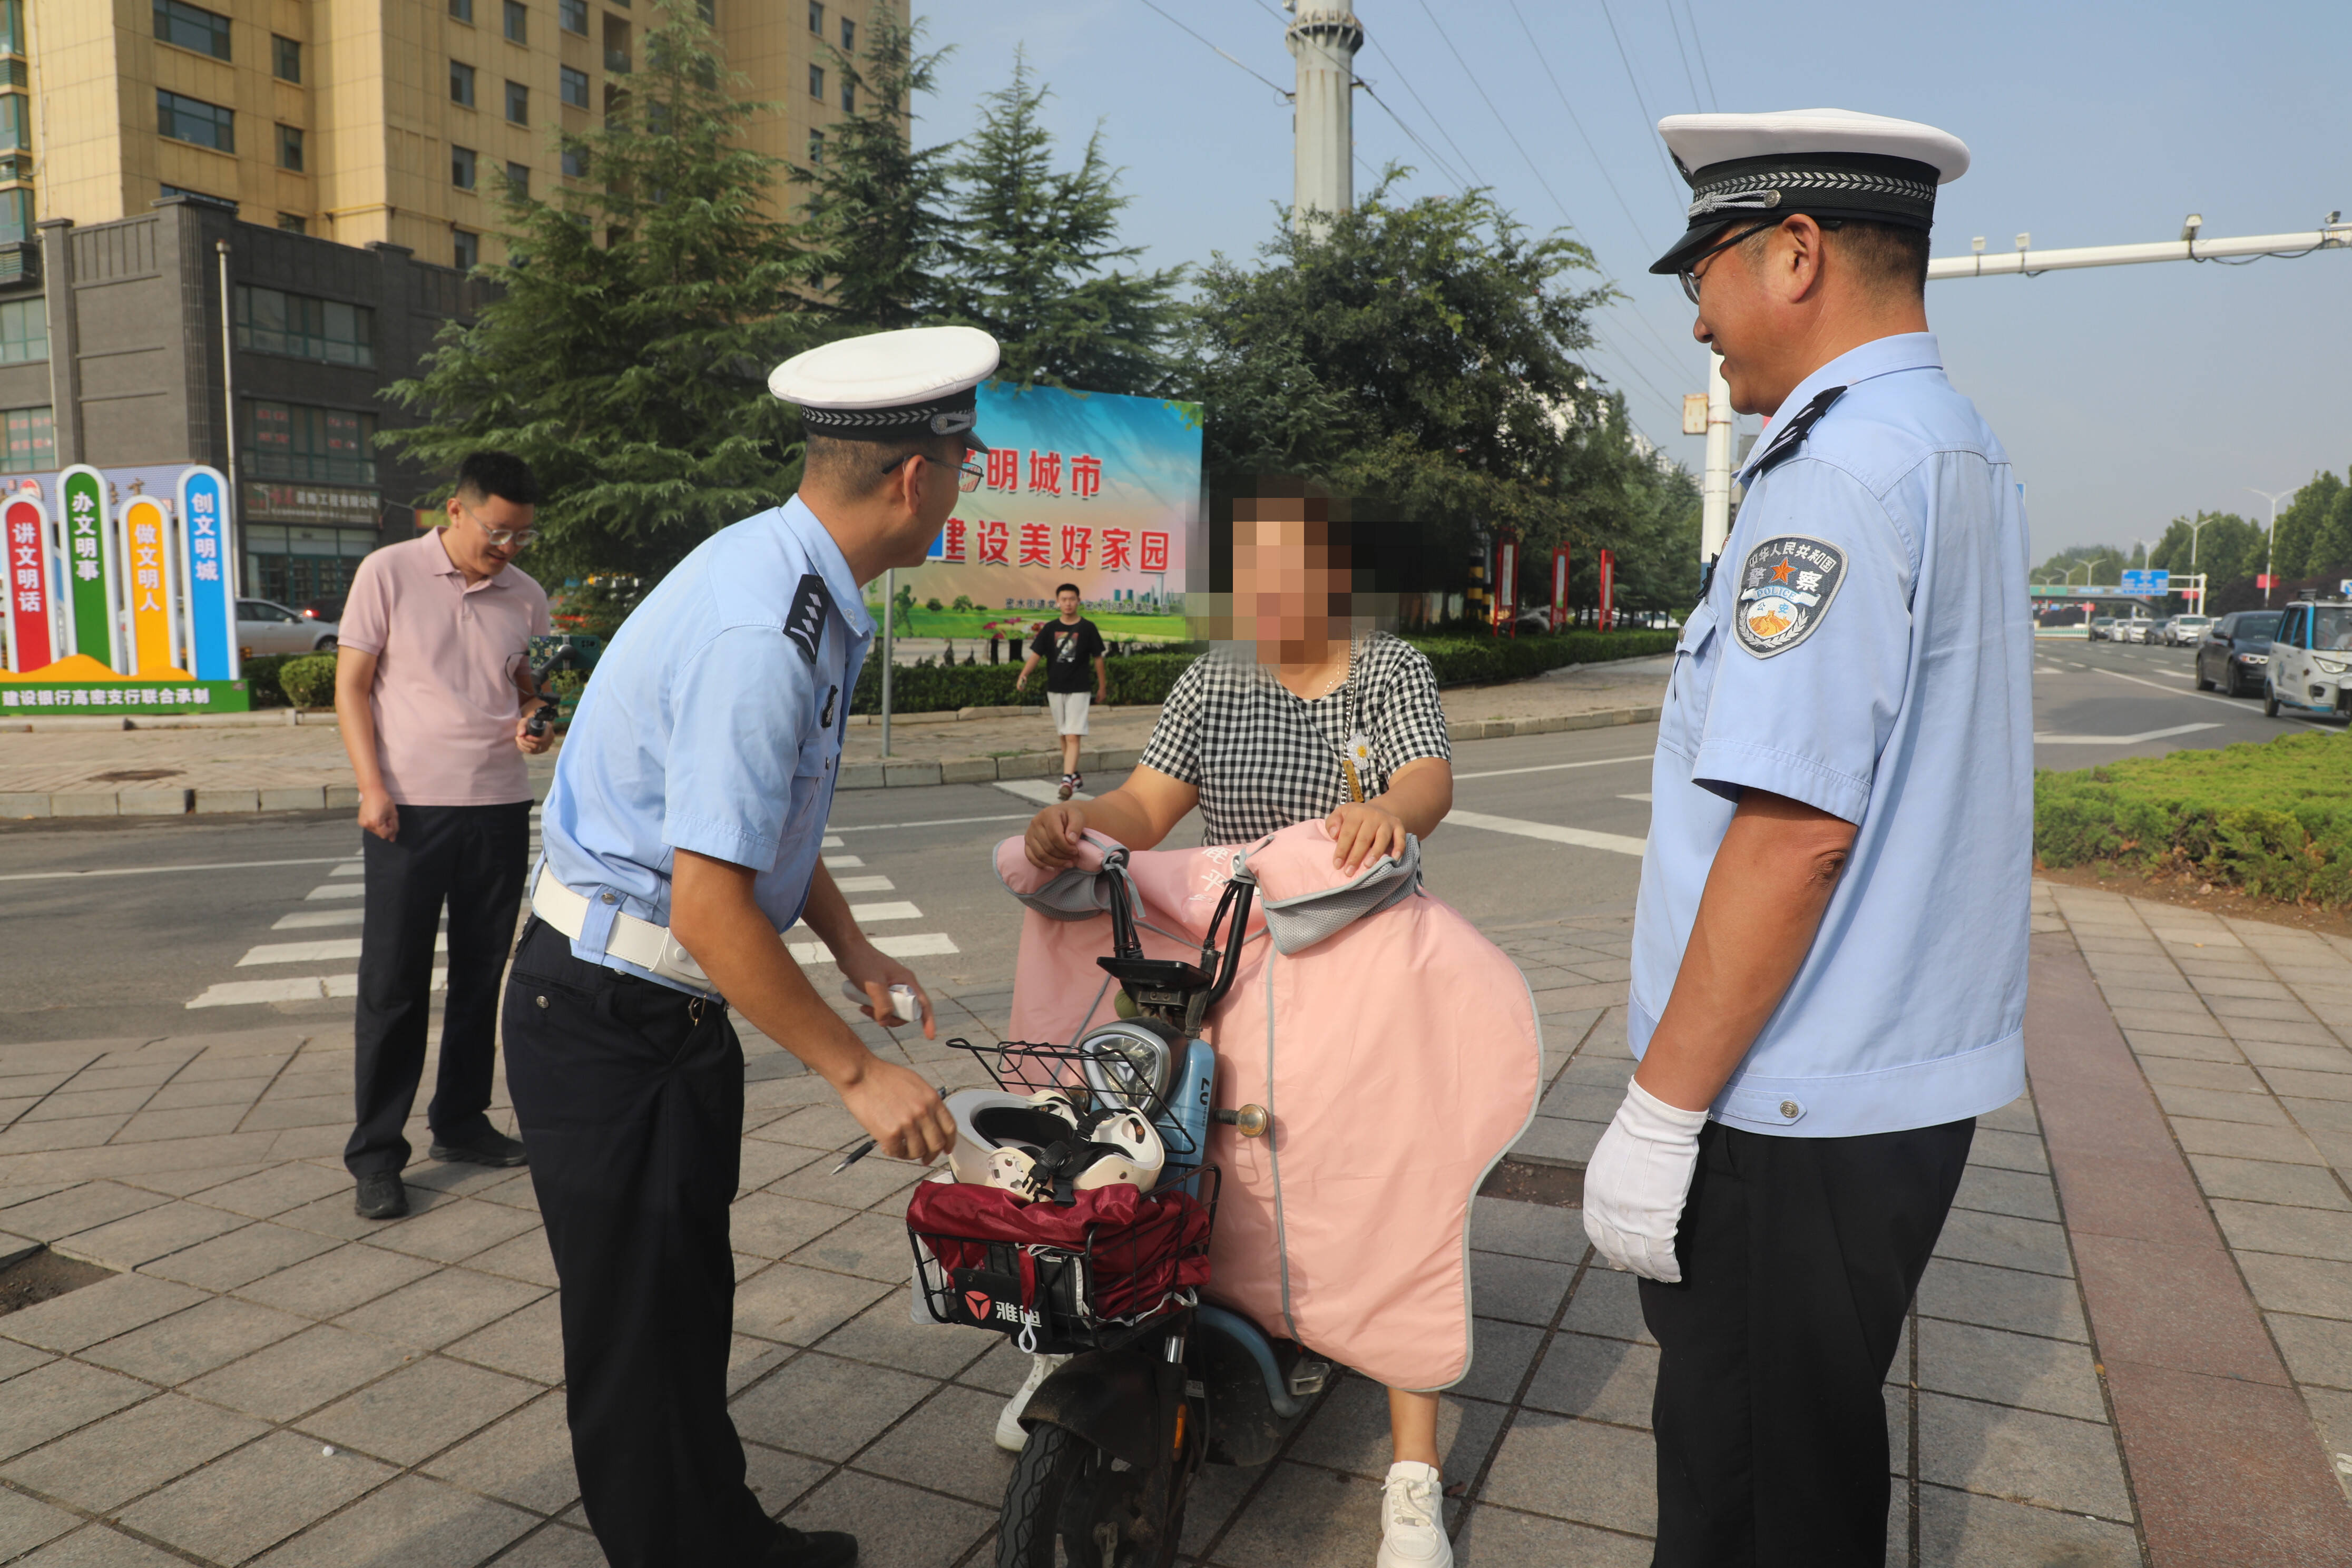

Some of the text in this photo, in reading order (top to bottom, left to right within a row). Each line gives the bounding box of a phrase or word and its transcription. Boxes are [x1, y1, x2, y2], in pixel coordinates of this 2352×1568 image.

[72, 492, 99, 581] 办文明事
[191, 493, 219, 581] 创文明城
[946, 517, 1169, 571] 建设美好家园
[13, 523, 42, 613] 讲文明话
[135, 524, 161, 611] 做文明人
[1749, 542, 1837, 573] 中华人民共和国
[1747, 567, 1822, 592] 警 察
[1756, 586, 1798, 600] POLICE
[1006, 598, 1060, 609] 密水街道党
[1757, 602, 1789, 614] 公 安
[2, 688, 210, 707] 建设银行高密支行联合承制
[995, 1301, 1042, 1327] 雅迪
